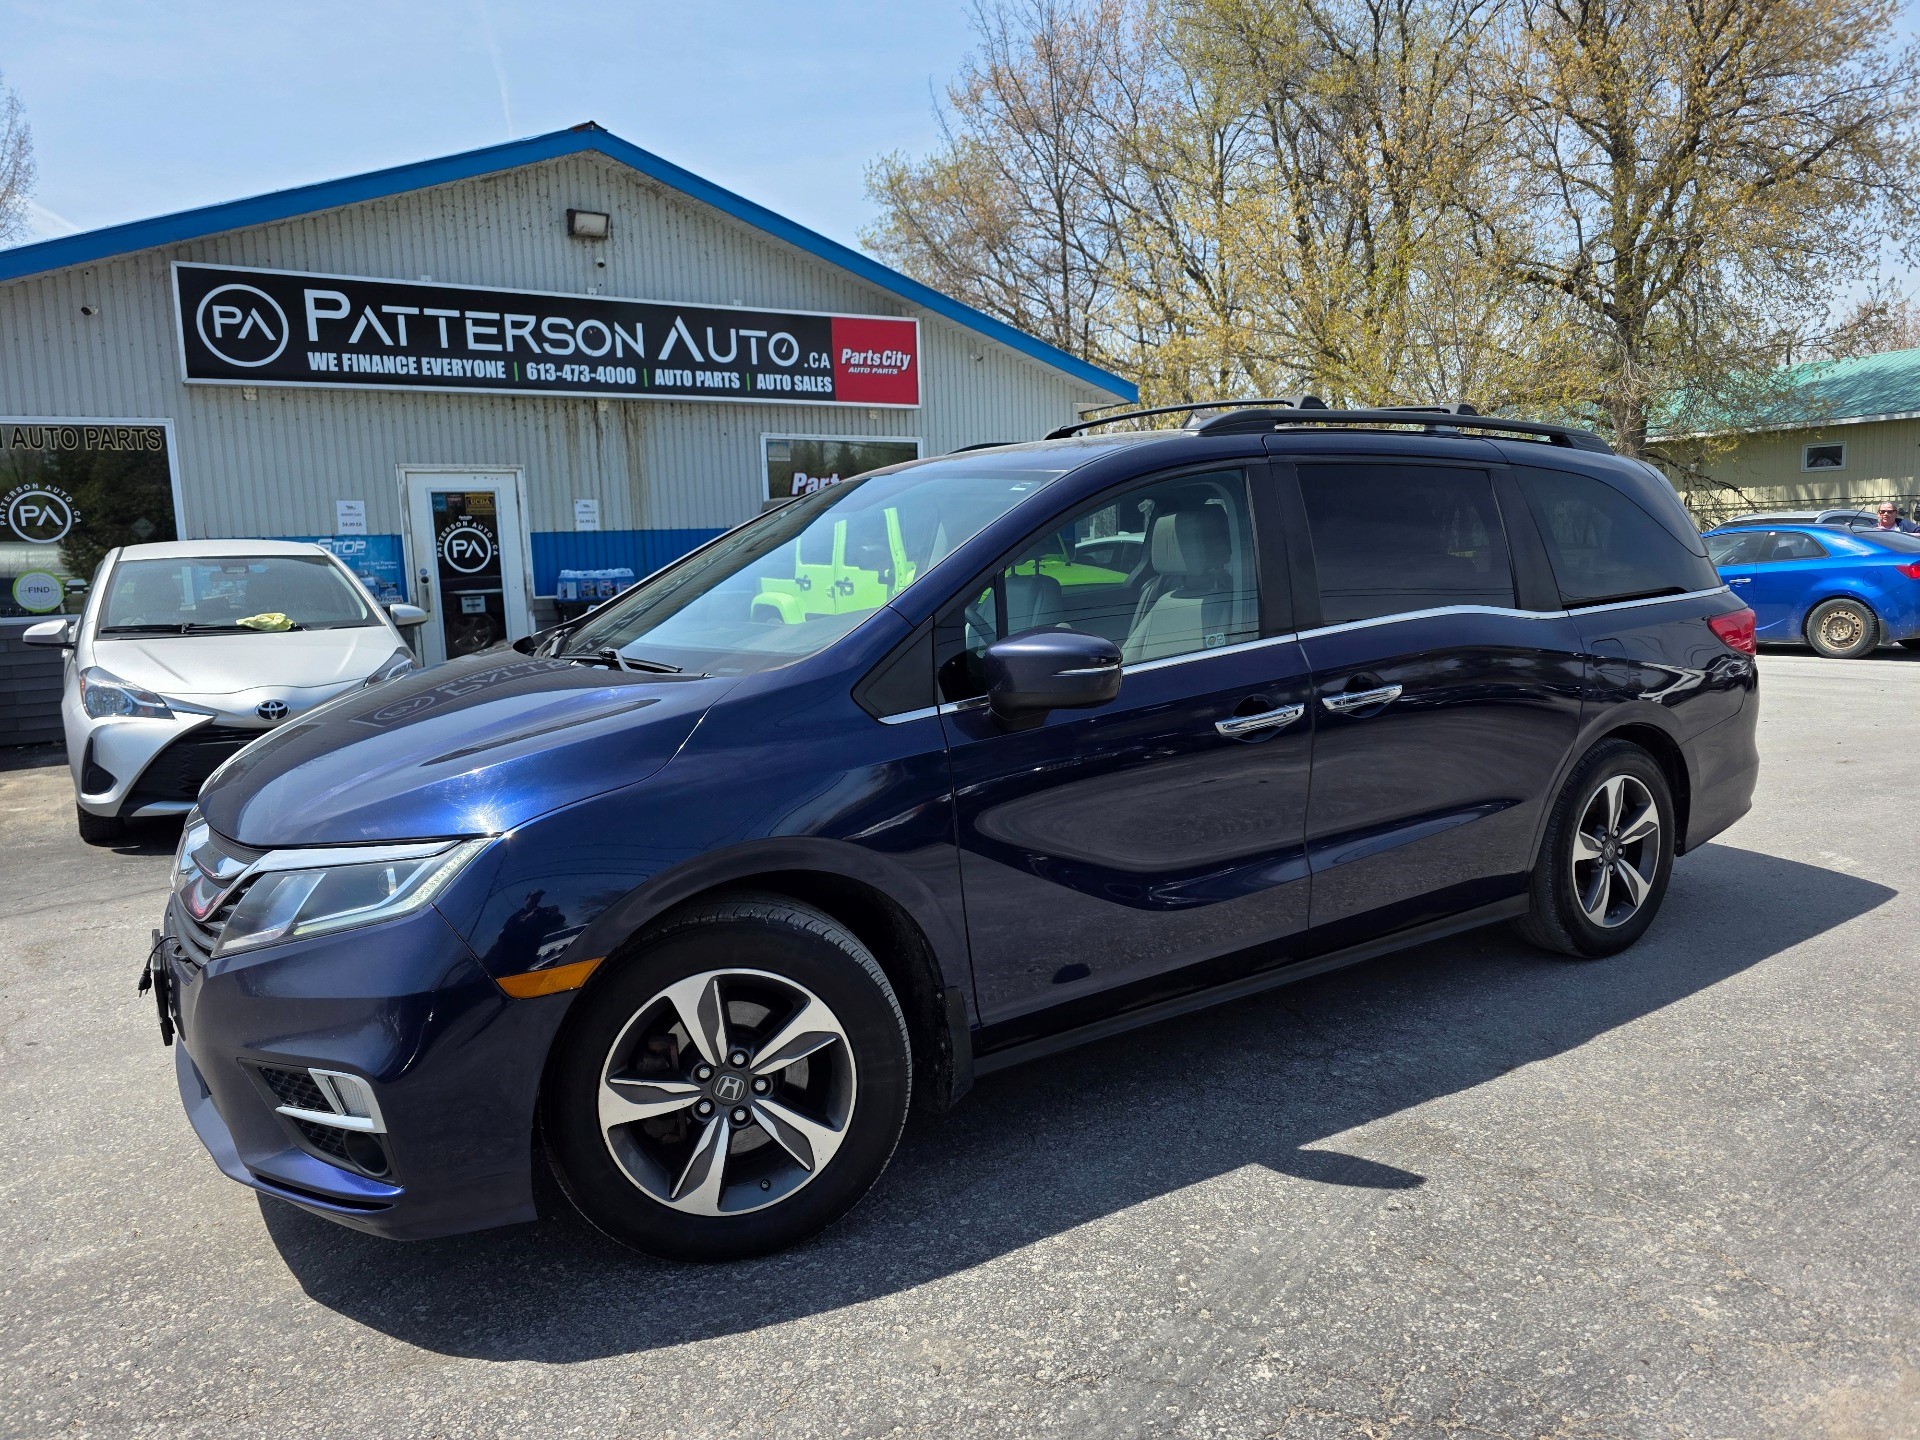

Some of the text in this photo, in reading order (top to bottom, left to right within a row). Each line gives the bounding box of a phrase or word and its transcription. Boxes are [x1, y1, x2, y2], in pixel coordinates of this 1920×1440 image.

[212, 304, 277, 341] PA
[303, 288, 831, 370] PATTERSON AUTO .CA
[307, 352, 637, 386] WE FINANCE EVERYONE 613-473-4000
[654, 368, 741, 390] AUTO PARTS
[756, 372, 833, 394] AUTO SALES
[11, 427, 78, 450] AUTO
[85, 427, 162, 450] PARTS
[0, 483, 39, 526] PATTERSON
[45, 484, 73, 503] AUTO
[318, 539, 366, 554] STOP
[437, 521, 468, 557] PATTERSON
[472, 522, 493, 538] AUTO
